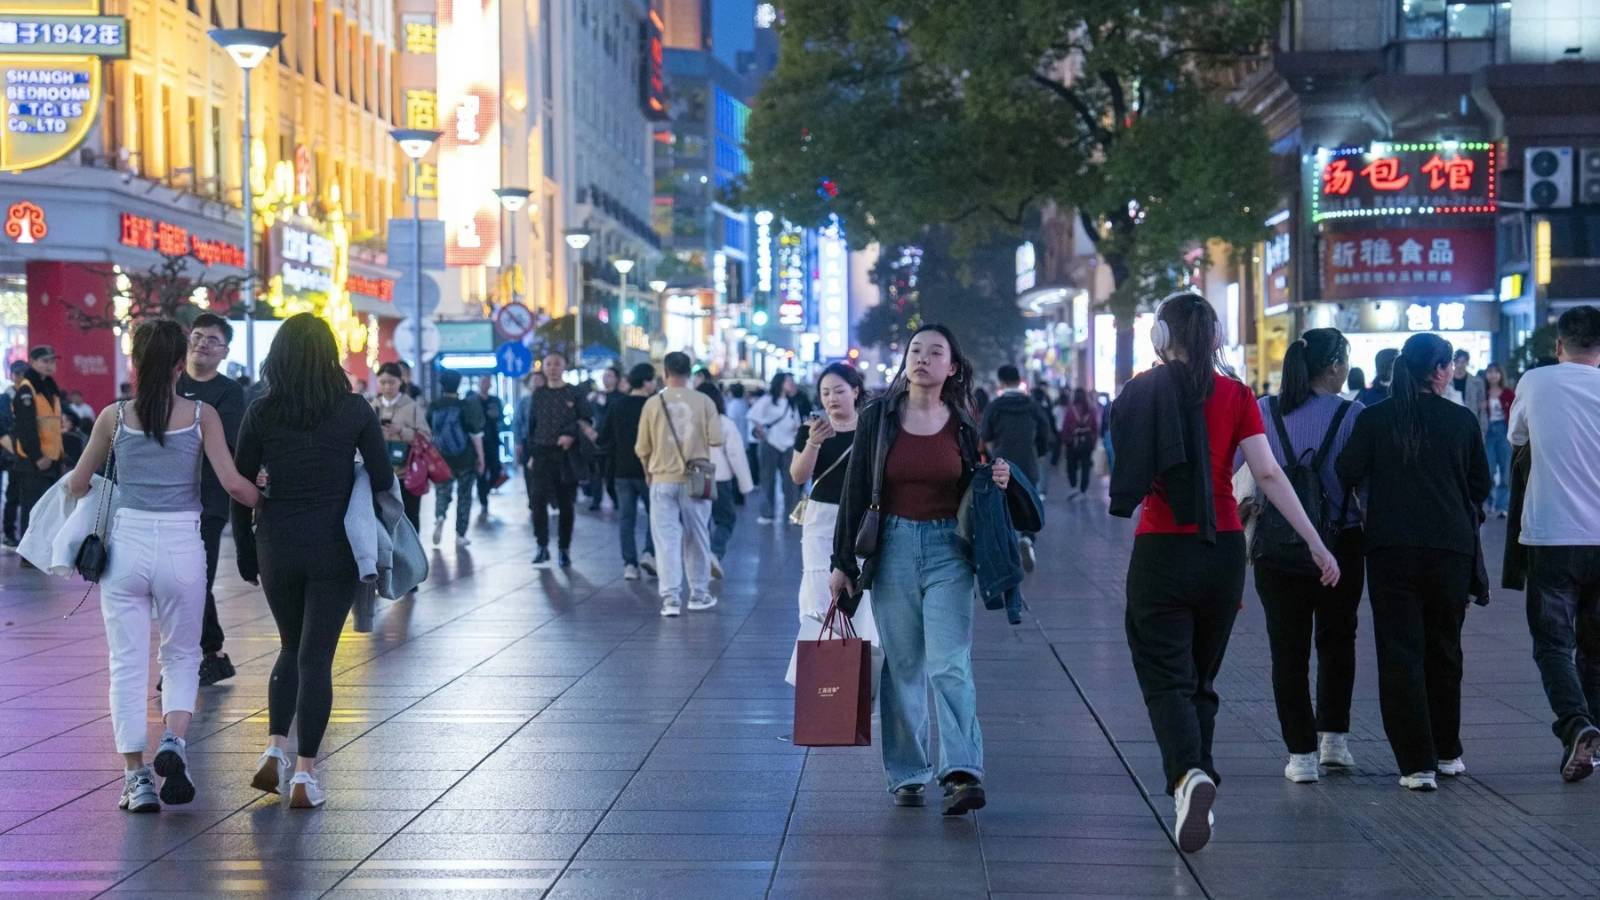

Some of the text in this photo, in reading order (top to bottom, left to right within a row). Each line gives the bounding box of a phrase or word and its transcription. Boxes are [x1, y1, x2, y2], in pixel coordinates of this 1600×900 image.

[0, 22, 120, 43] 于1942年
[1323, 154, 1475, 195] 汤包馆
[1332, 238, 1454, 268] 新雅食品
